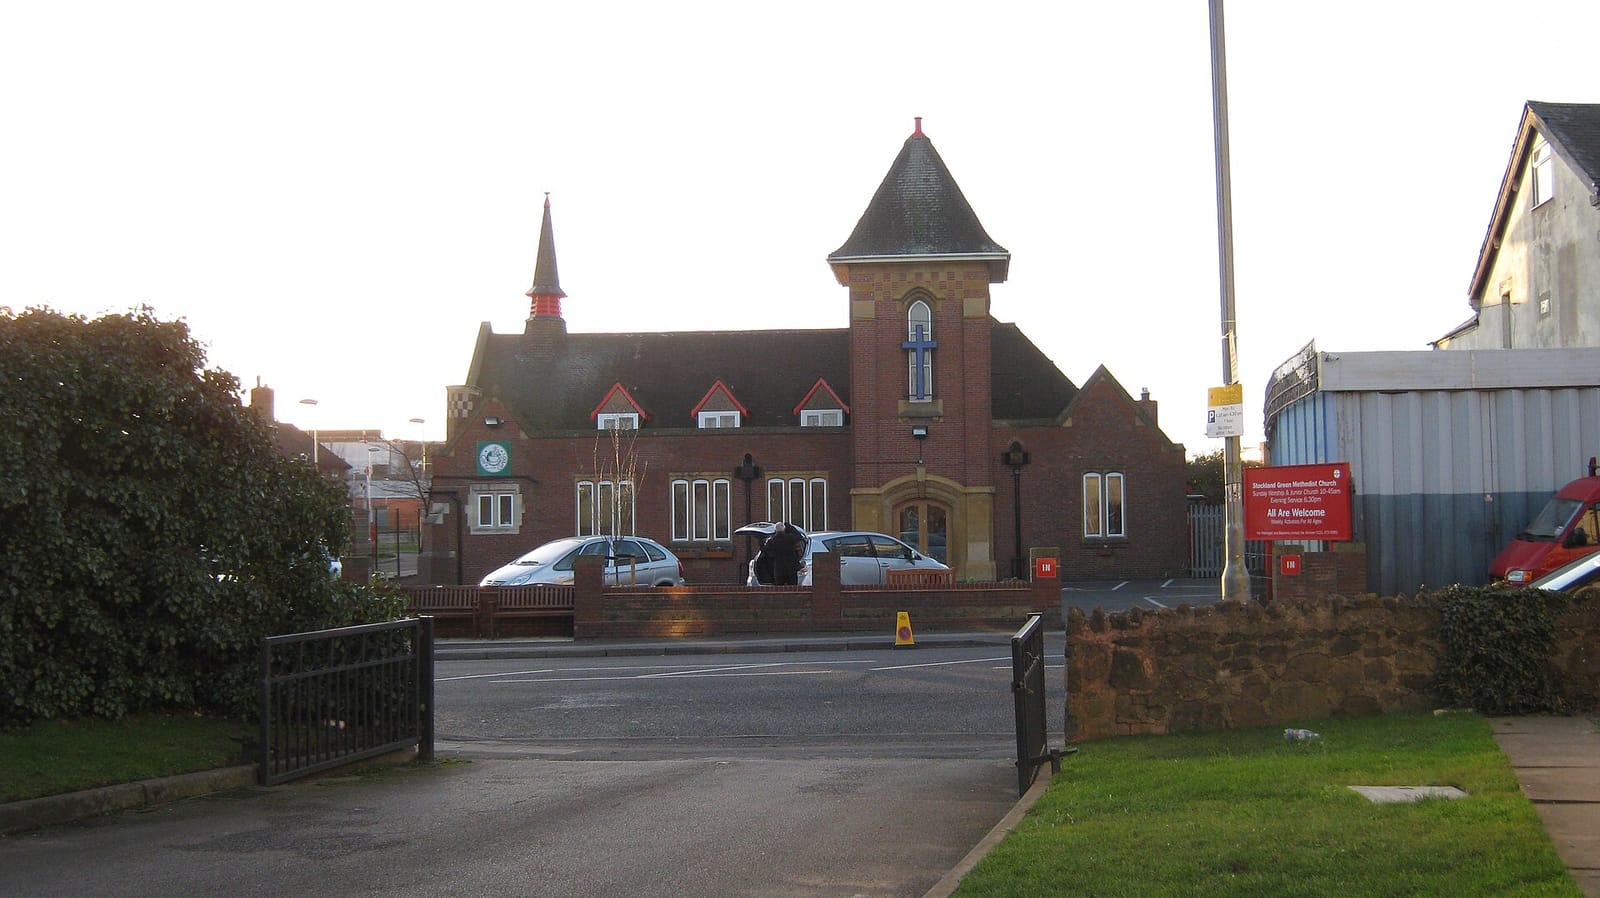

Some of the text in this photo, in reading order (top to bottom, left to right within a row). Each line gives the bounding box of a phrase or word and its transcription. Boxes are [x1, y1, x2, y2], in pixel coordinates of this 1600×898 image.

[1292, 480, 1317, 488] Methodist
[1252, 490, 1268, 498] Sunday
[1267, 508, 1325, 517] All Are Welcome
[1042, 563, 1051, 572] IN
[1286, 560, 1295, 569] IN
